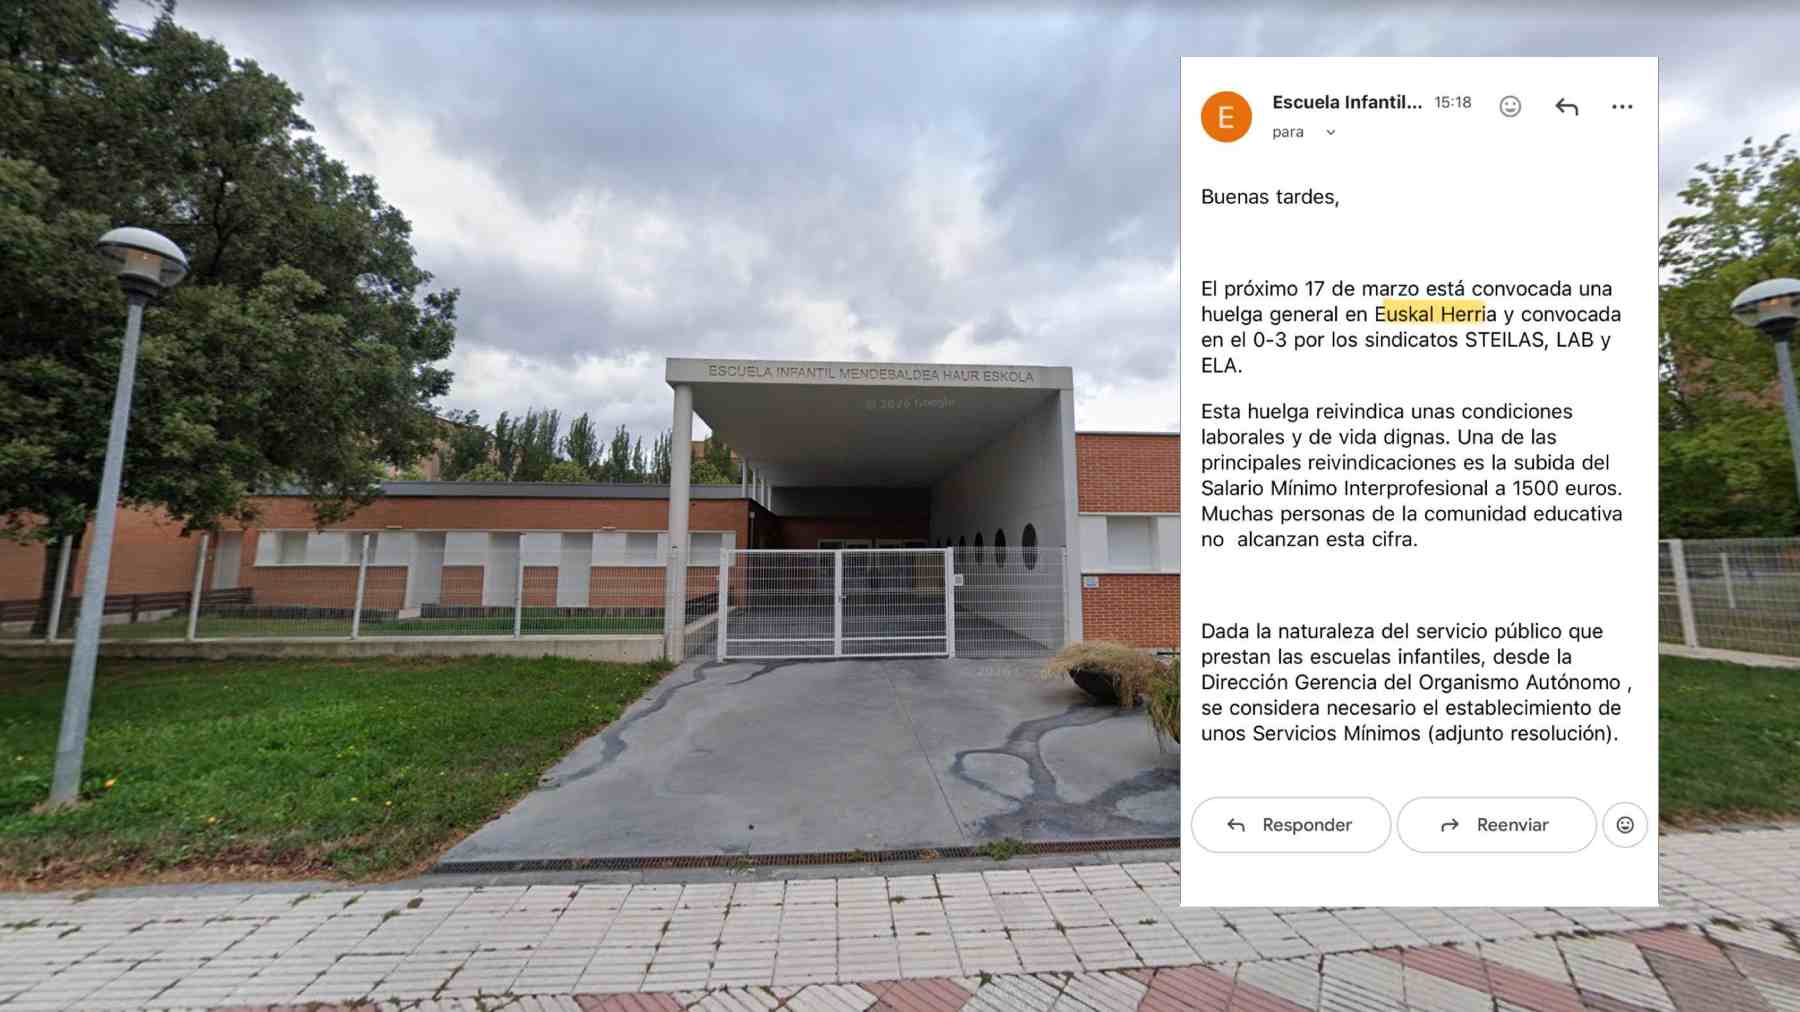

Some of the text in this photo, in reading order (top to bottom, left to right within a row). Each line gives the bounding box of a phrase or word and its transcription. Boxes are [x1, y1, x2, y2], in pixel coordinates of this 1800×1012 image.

[708, 365, 772, 378] ESCUELA
[775, 366, 836, 379] INFANTIL
[943, 369, 980, 382] HAUR
[983, 370, 1035, 383] ESKOLA
